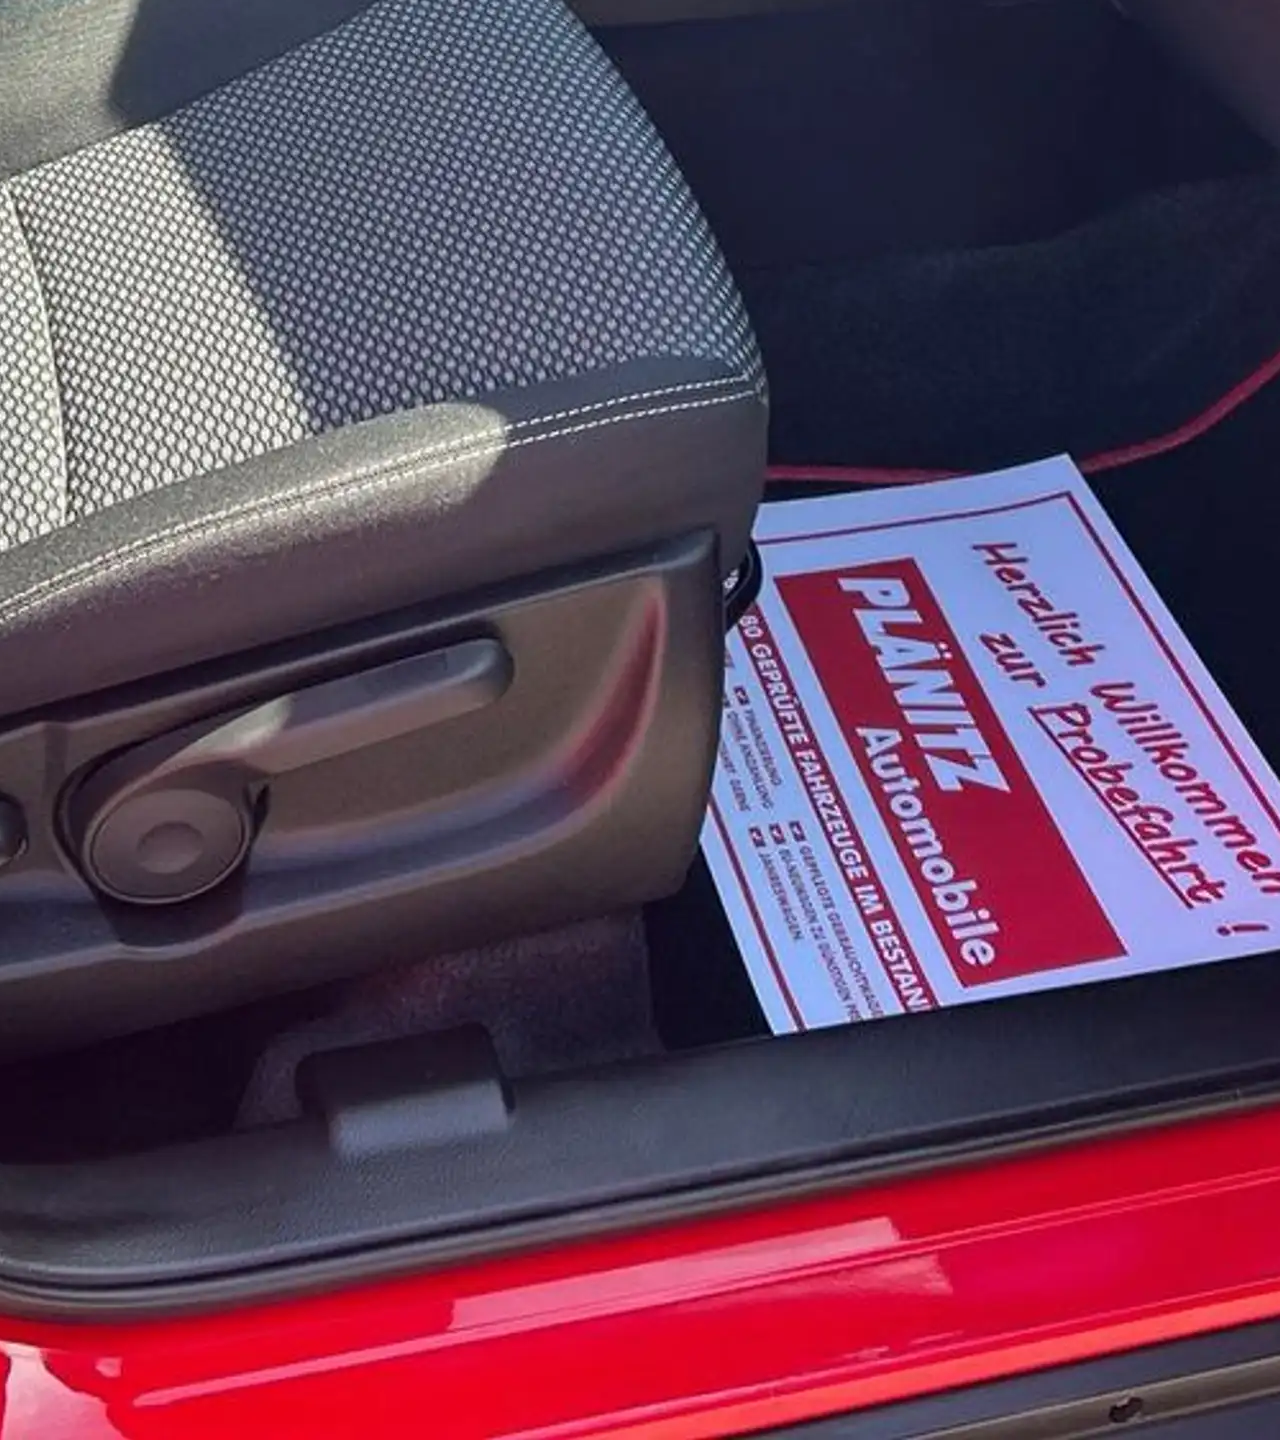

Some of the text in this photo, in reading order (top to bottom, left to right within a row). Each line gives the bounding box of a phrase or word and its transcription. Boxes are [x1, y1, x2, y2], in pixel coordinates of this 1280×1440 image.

[836, 578, 1010, 792] PLÄNITZ
[971, 542, 1105, 667] Herzlich
[737, 614, 930, 1010] 80 GEPRÜFTE FAHRZEUGE IM BESTAN
[854, 727, 997, 964] Automobile
[978, 633, 1269, 935] zur Probefahrt !
